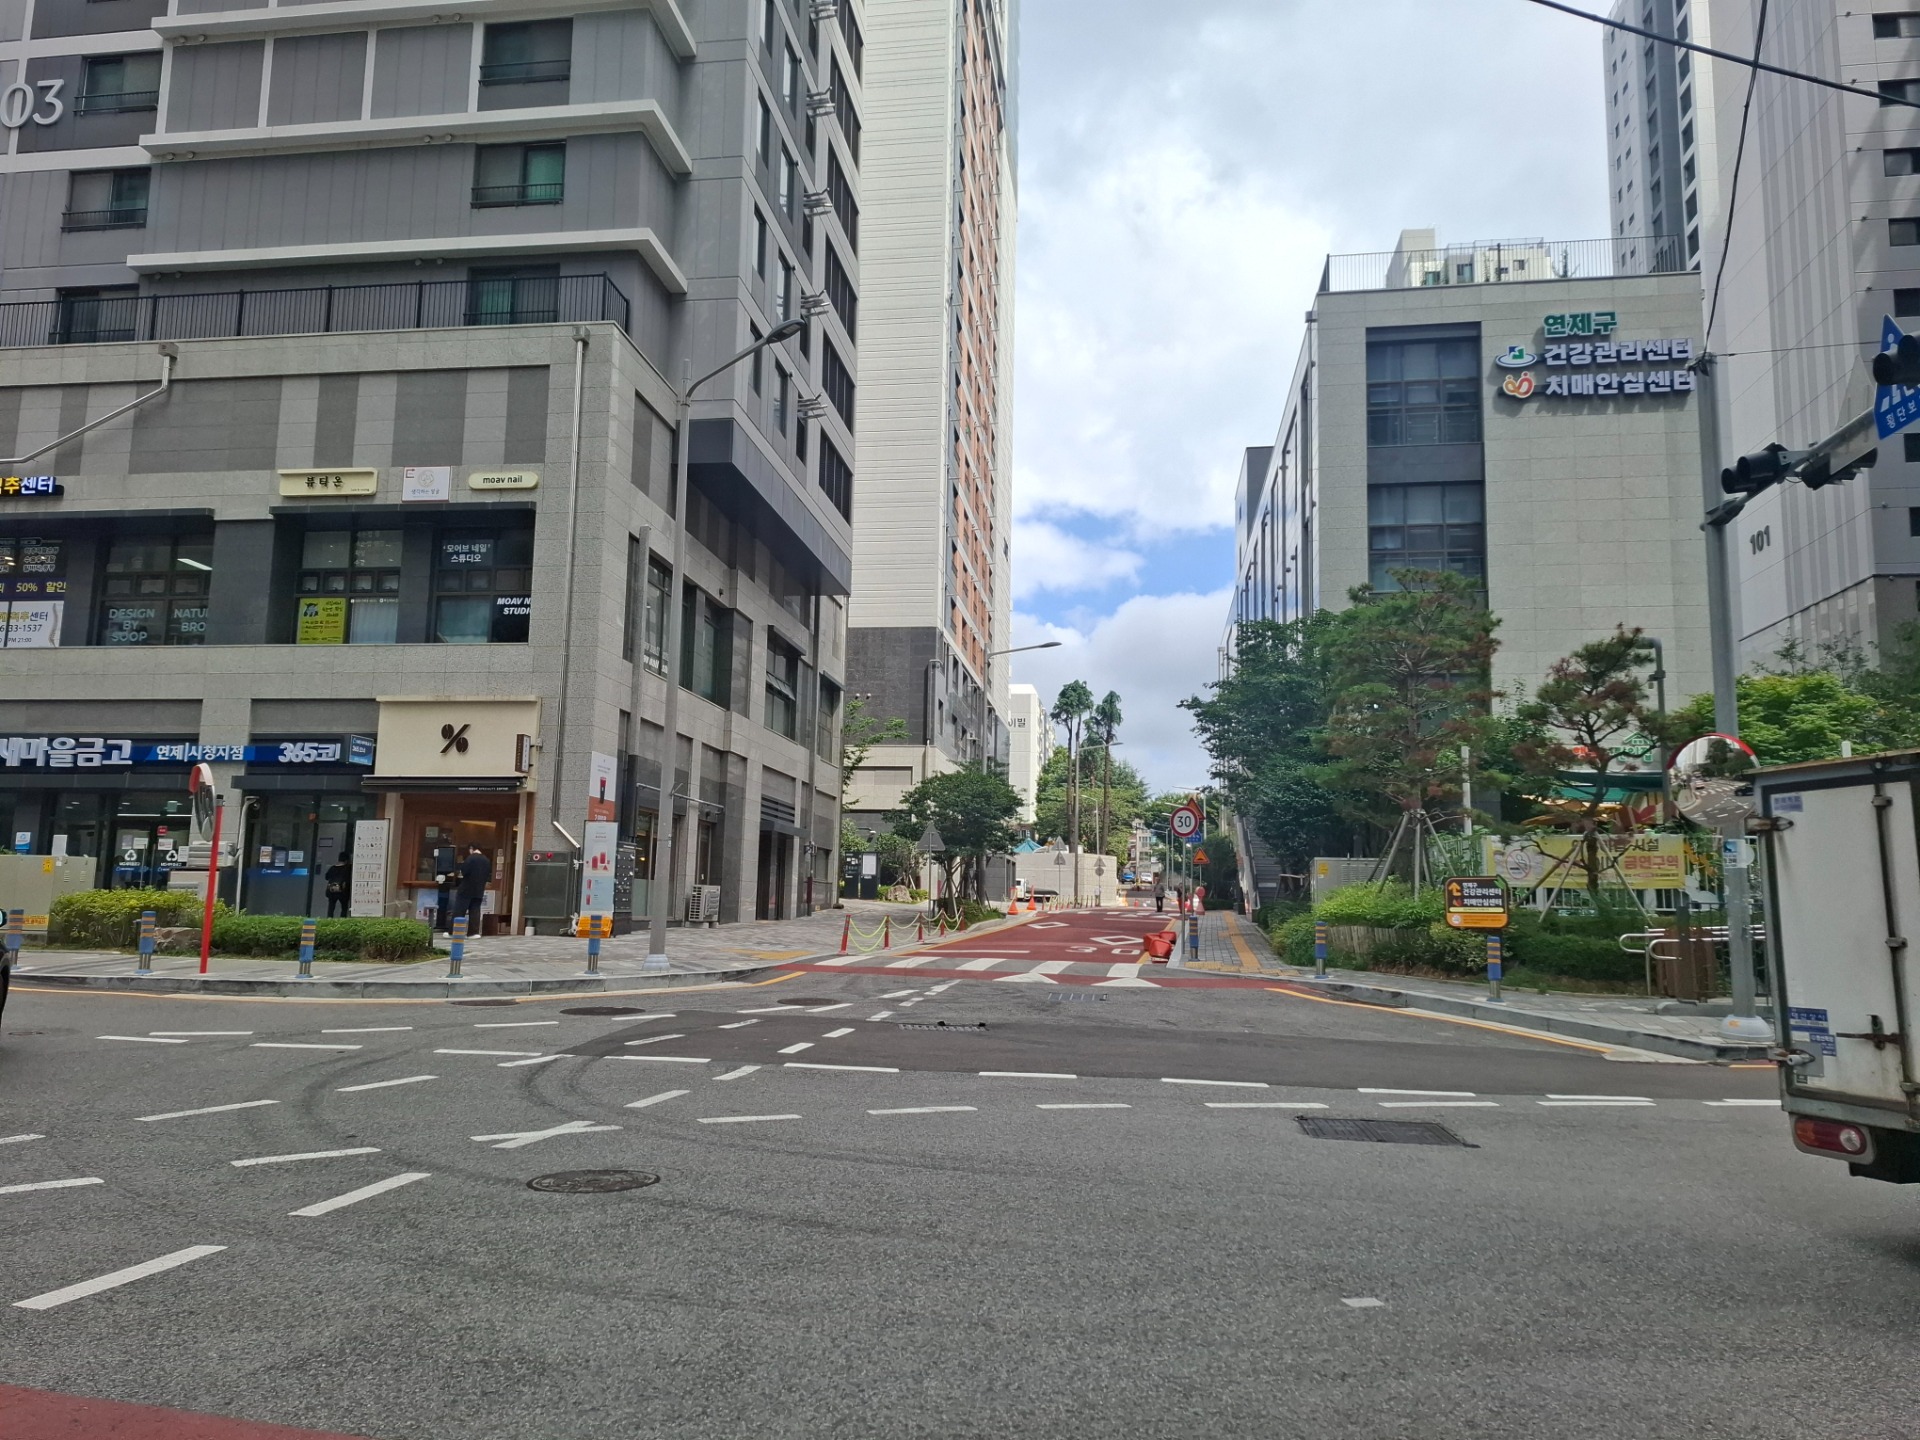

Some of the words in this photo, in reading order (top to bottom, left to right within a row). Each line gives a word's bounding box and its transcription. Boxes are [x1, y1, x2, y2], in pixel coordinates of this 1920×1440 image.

[1543, 311, 1618, 338] 연제구
[1544, 338, 1694, 366] 건강관리센터
[1545, 370, 1697, 397] 치매안심센터
[1886, 396, 1920, 429] 횡단보
[482, 476, 506, 484] moav
[507, 475, 523, 483] nail
[0, 476, 54, 495] 추센터
[1750, 525, 1770, 555] 101
[450, 554, 482, 563] 스튜디오
[16, 582, 38, 592] 50%
[46, 581, 66, 592] 할인
[496, 597, 522, 605] MOAV
[108, 608, 155, 619] DESIGN
[174, 608, 208, 618] NATU
[503, 607, 532, 615] STUDI
[123, 620, 140, 630] BY
[111, 631, 147, 641] SOOP
[0, 737, 132, 767] 새마을금고
[1177, 815, 1192, 828] 30
[1624, 855, 1679, 870] 금연구역
[1065, 945, 1141, 956] 30
